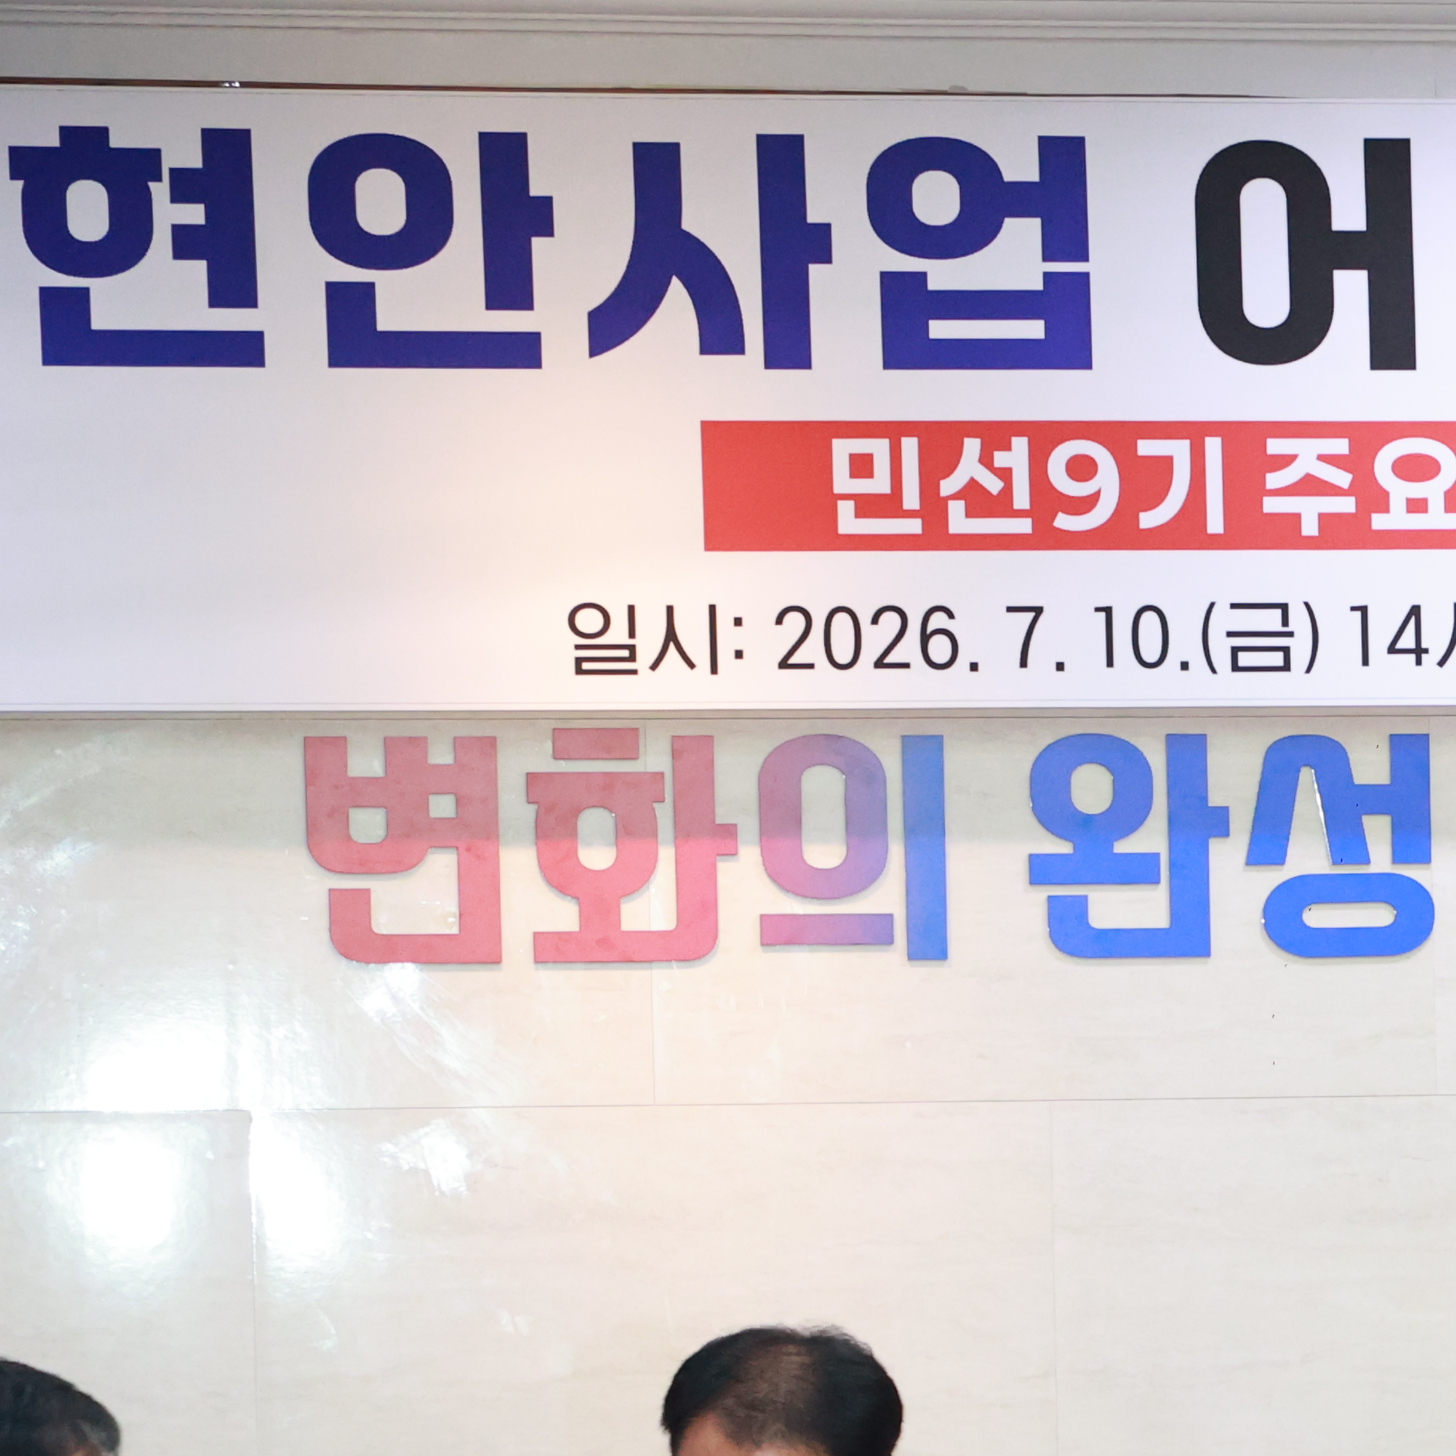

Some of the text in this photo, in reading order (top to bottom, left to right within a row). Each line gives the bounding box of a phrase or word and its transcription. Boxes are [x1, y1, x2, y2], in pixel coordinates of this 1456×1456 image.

[8, 125, 1092, 370] 현안사업
[832, 437, 1224, 534] 민선9기
[568, 603, 743, 675] 일시:
[775, 605, 978, 672] 2026.
[1006, 606, 1064, 671] 7.
[1094, 602, 1319, 674] 10.(금)
[303, 727, 946, 964] 변화의
[1029, 733, 1434, 958] 완성
